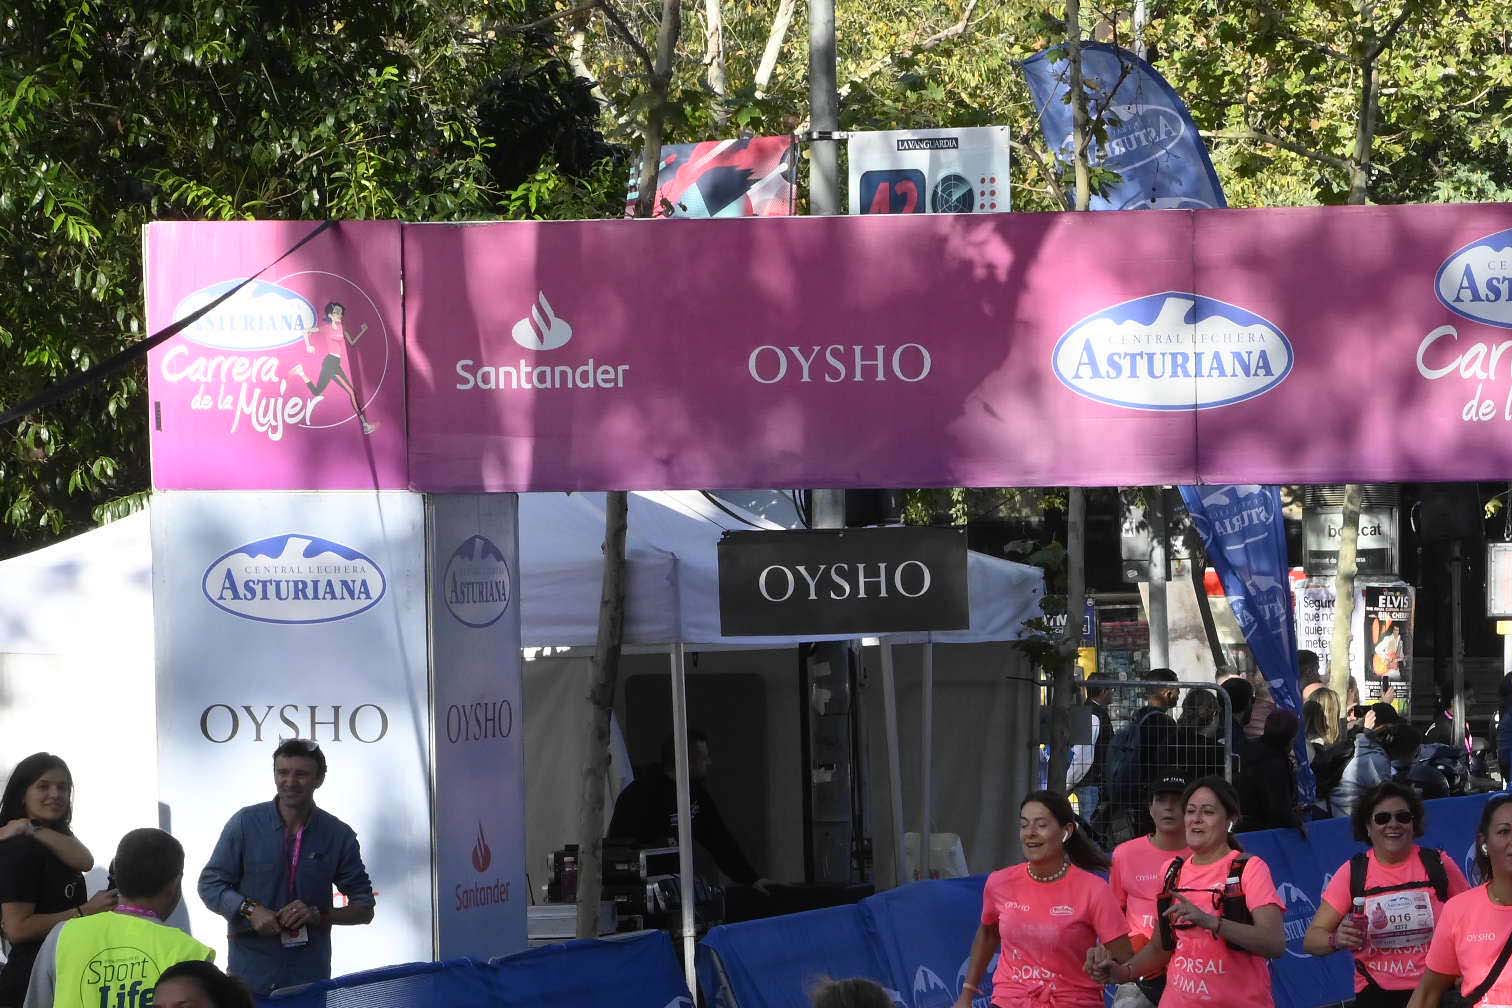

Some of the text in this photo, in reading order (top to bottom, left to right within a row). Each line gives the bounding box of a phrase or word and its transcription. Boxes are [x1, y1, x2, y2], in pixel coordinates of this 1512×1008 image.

[1108, 333, 1183, 345] CENTRAL
[161, 345, 280, 383] Carrera
[455, 357, 630, 391] Santander
[748, 343, 932, 384] OYSHO
[1072, 338, 1274, 380] ASTURIANA
[190, 380, 325, 441] de la Mujer
[1462, 384, 1496, 422] de
[216, 568, 372, 602] ASTURIANA
[244, 565, 367, 575] CENTRAL LECHERA
[758, 560, 931, 602] OYSHO
[449, 571, 507, 604] ASTURIANA
[1379, 596, 1409, 608] ELVIS
[200, 704, 389, 744] OYSHO
[446, 700, 512, 744] OYSHO
[455, 879, 511, 912] Santander
[1390, 913, 1411, 923] 016
[1466, 932, 1495, 942] OYSHO
[88, 957, 148, 987] Sport
[1368, 960, 1417, 972] SUMA
